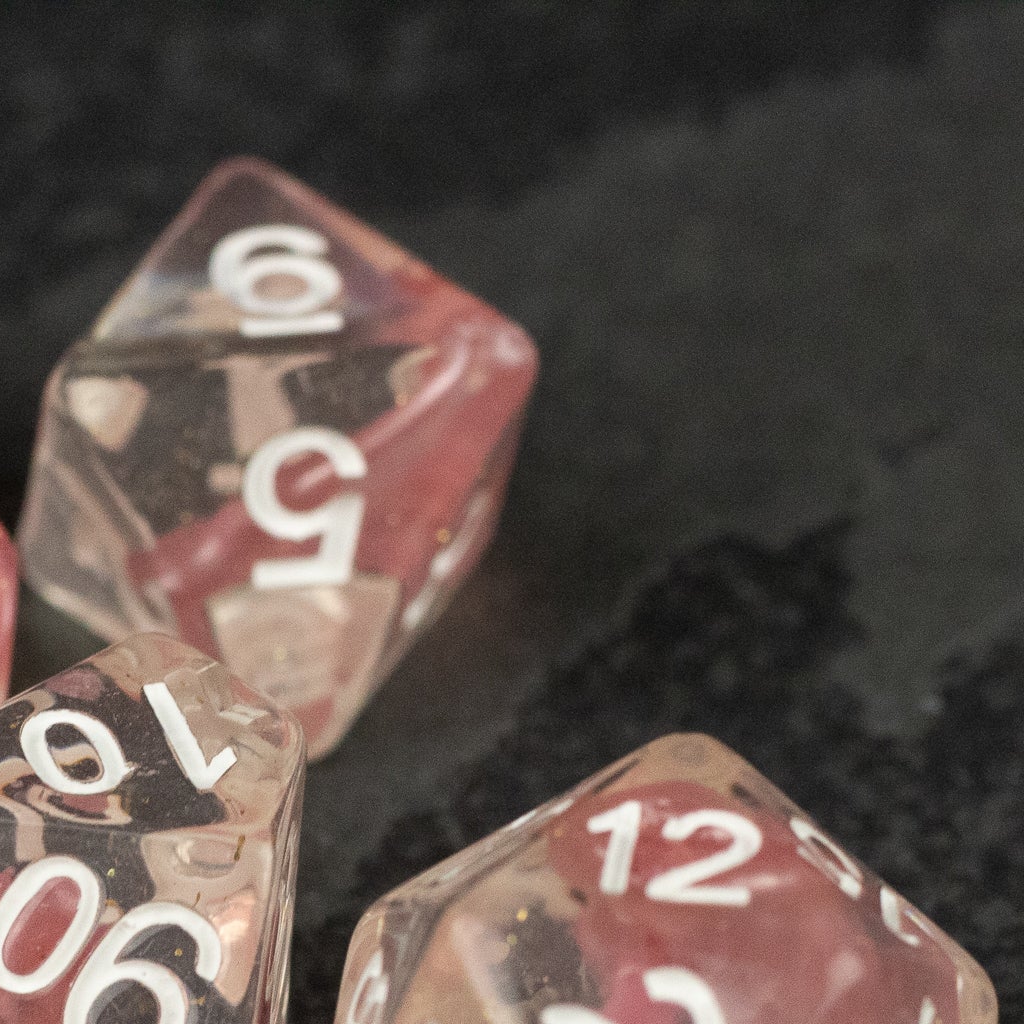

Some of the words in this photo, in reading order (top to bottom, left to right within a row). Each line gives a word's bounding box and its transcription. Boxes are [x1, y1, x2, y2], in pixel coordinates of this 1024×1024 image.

[209, 224, 344, 337] 6
[244, 426, 367, 588] 5
[21, 681, 238, 796] 10
[588, 800, 761, 906] 12
